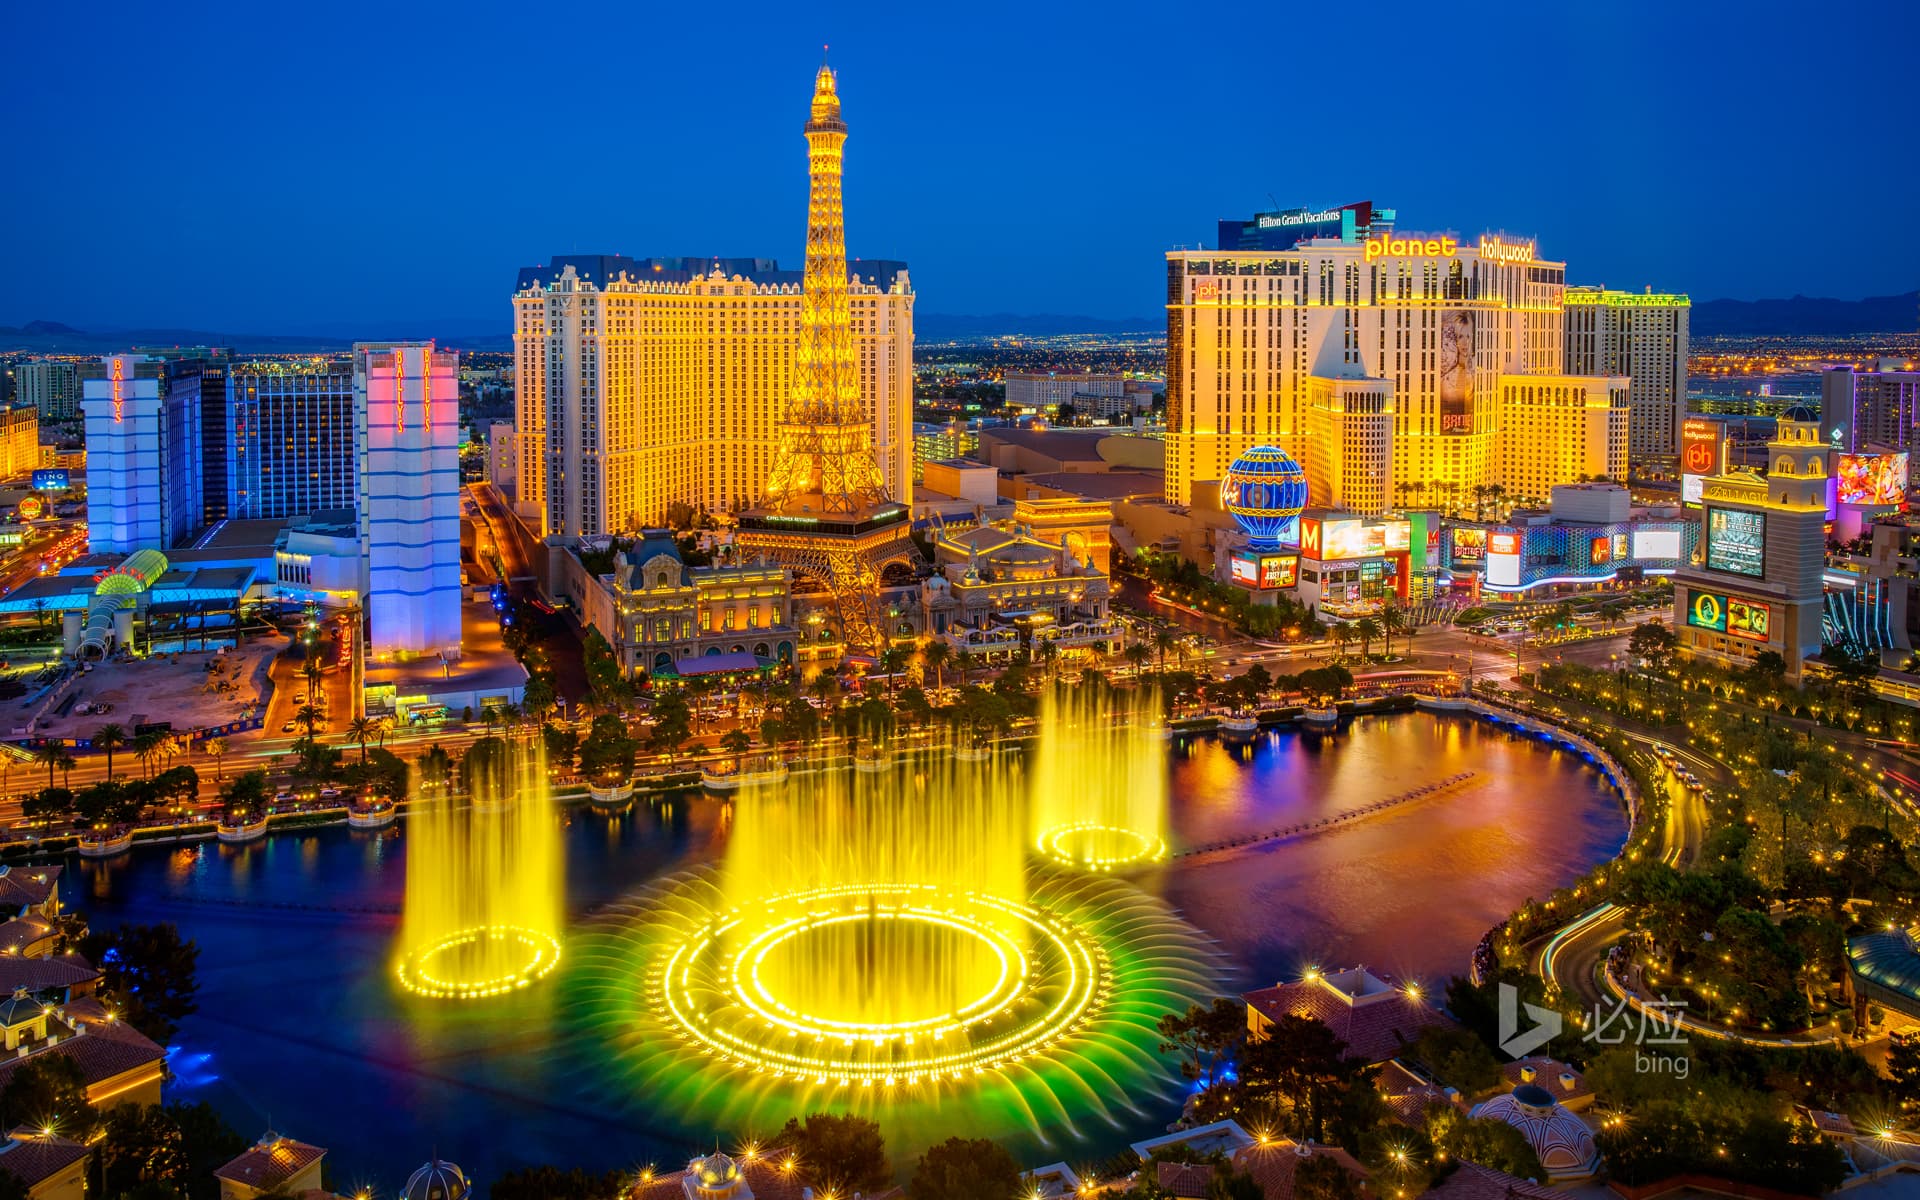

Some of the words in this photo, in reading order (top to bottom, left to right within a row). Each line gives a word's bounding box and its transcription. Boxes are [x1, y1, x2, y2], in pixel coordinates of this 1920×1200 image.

[1260, 217, 1281, 228] Hilton
[1282, 213, 1304, 226] Grand
[1304, 210, 1340, 224] Vacations
[1365, 233, 1457, 262] planet
[1481, 235, 1533, 266] hollywood
[113, 359, 124, 423] BALLYS
[1684, 422, 1705, 430] planet
[1684, 431, 1715, 440] hollywood
[1690, 444, 1712, 468] ph
[1711, 487, 1768, 504] BELLAGIO
[1302, 522, 1319, 551] M
